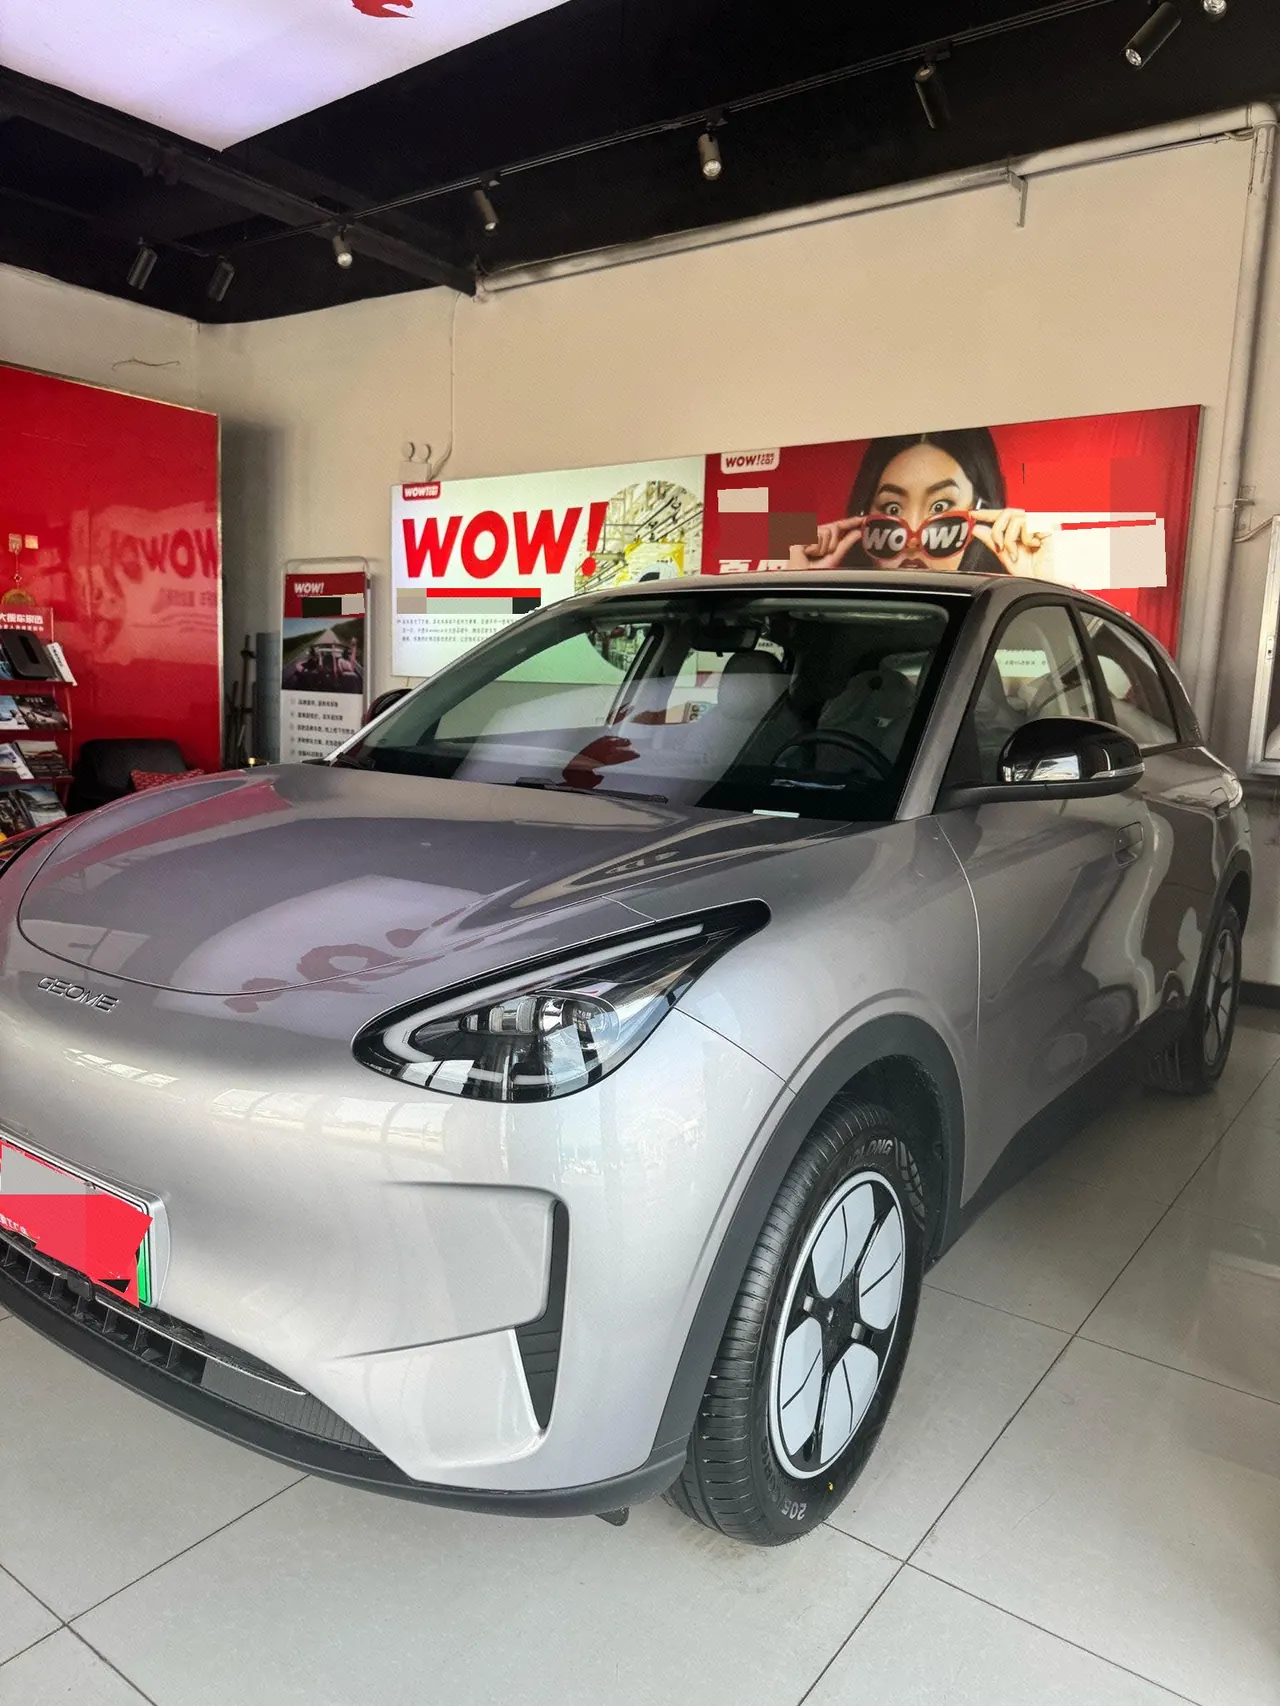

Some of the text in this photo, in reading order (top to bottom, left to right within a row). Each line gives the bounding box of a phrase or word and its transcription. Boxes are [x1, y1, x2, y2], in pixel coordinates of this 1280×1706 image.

[726, 454, 761, 468] WOW!
[404, 486, 429, 497] WOW!
[402, 501, 610, 579] WOW!
[294, 582, 325, 594] WOW!
[37, 976, 120, 1012] GEOME
